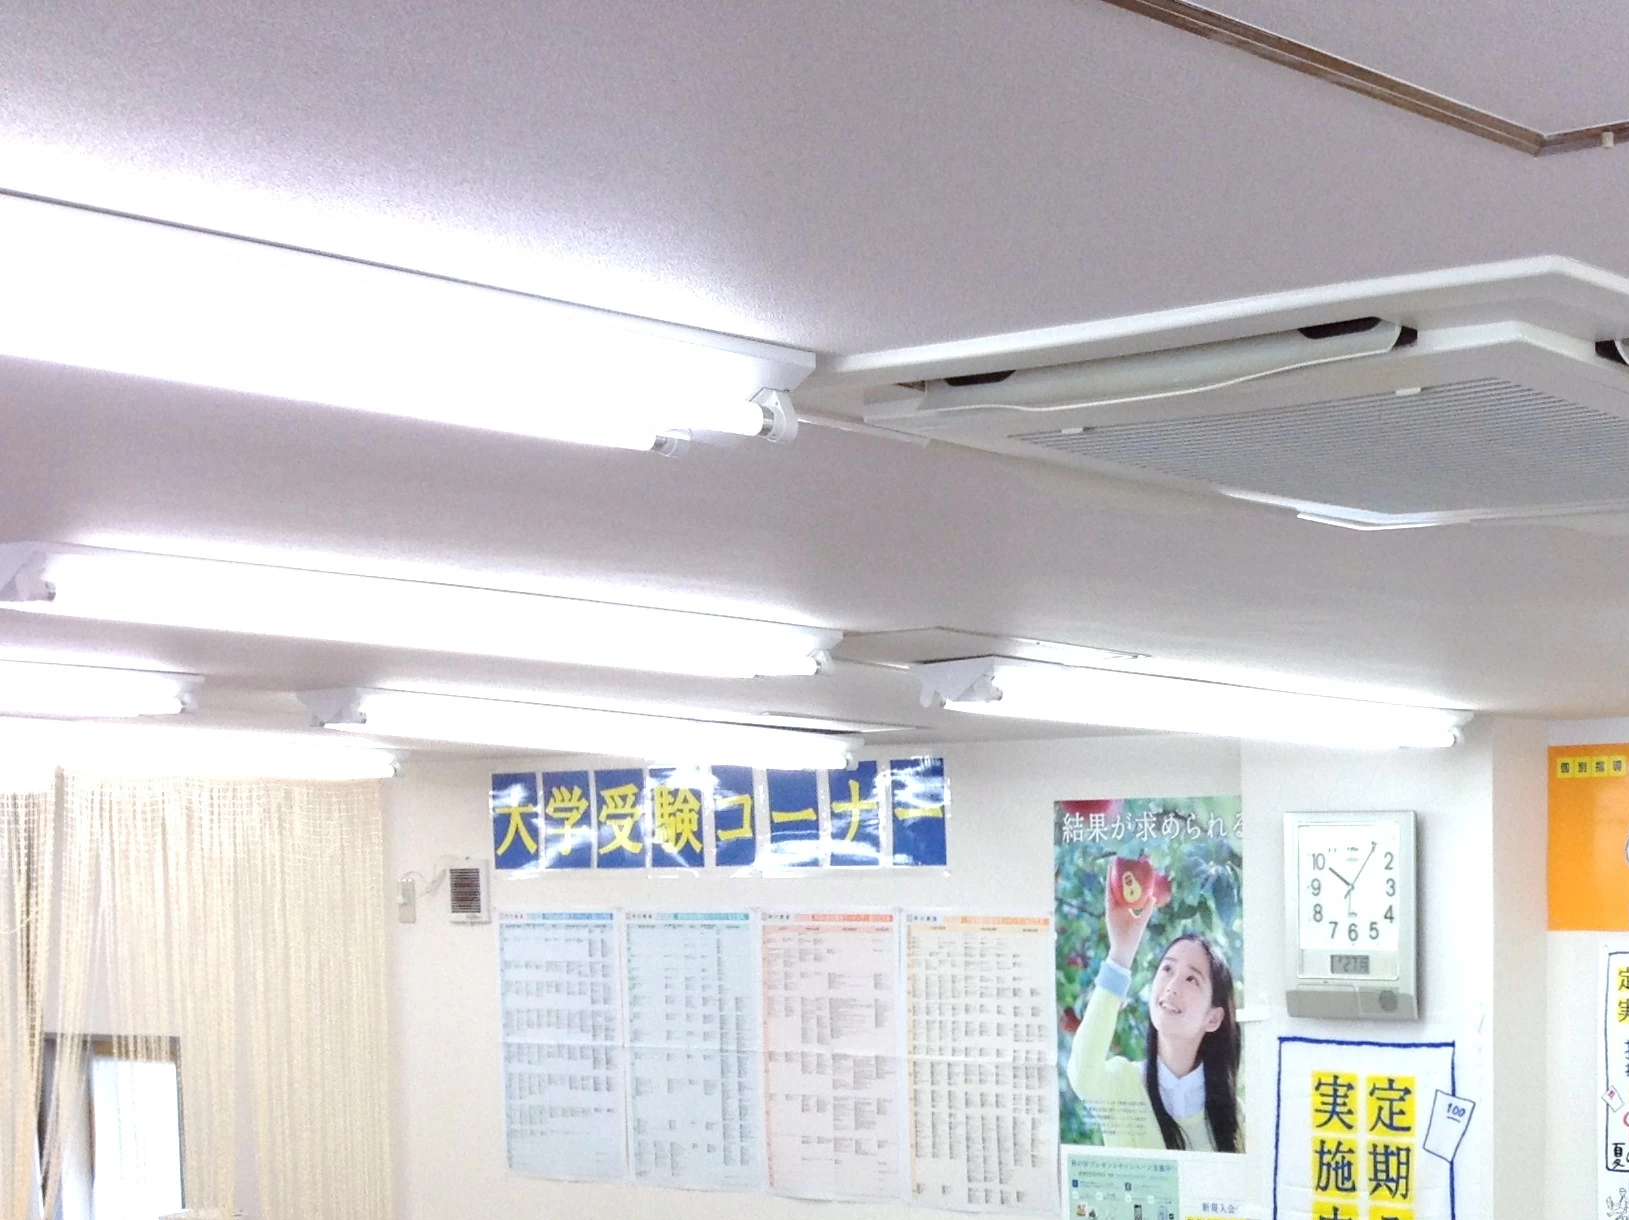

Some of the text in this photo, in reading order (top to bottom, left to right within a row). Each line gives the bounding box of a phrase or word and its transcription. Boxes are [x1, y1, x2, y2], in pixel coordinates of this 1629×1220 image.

[494, 778, 943, 856] 大学受験コーナー
[1312, 852, 1326, 871] 10
[1384, 851, 1394, 871] 2
[1310, 878, 1321, 897] 9
[1385, 878, 1396, 897] 3
[1313, 903, 1323, 923] 8
[1383, 904, 1395, 924] 4
[1328, 921, 1339, 939] 7
[1347, 922, 1359, 942] 6
[1368, 921, 1380, 940] 5
